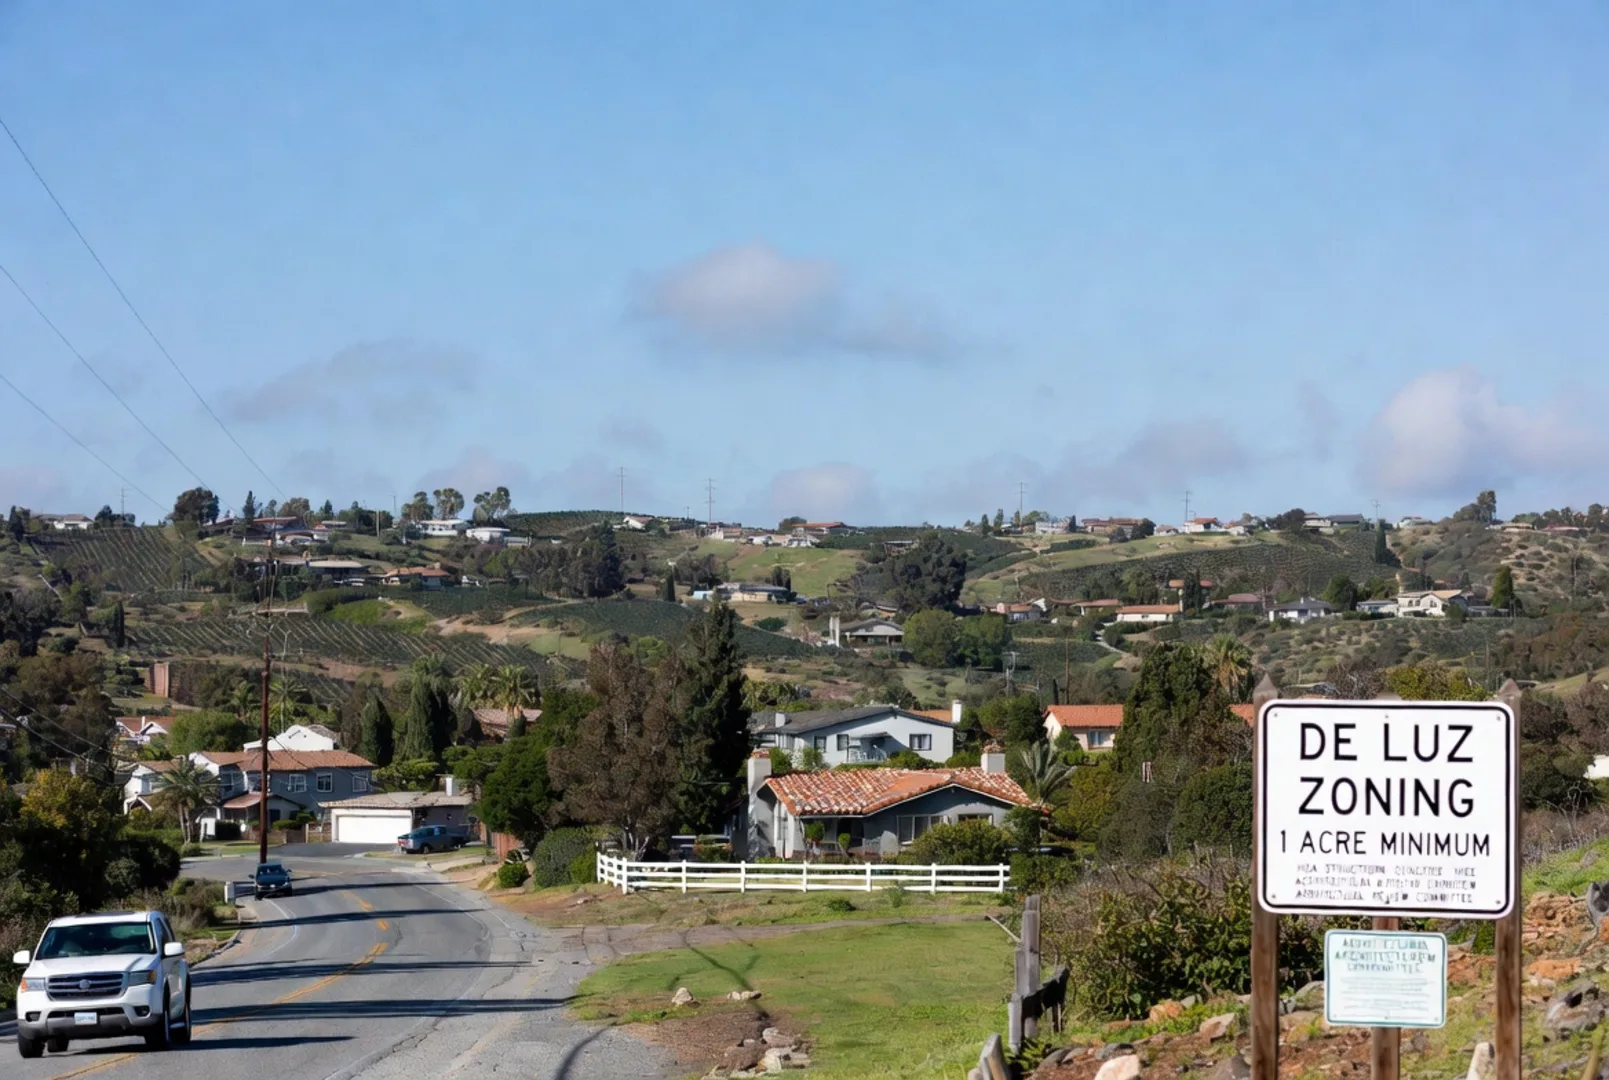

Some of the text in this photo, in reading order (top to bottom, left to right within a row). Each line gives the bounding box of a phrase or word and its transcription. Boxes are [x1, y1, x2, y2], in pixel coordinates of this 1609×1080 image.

[1300, 722, 1474, 763] DE LUZ
[1298, 776, 1475, 818] ZONING
[1280, 829, 1490, 857] 1 ACRE MINIMUM
